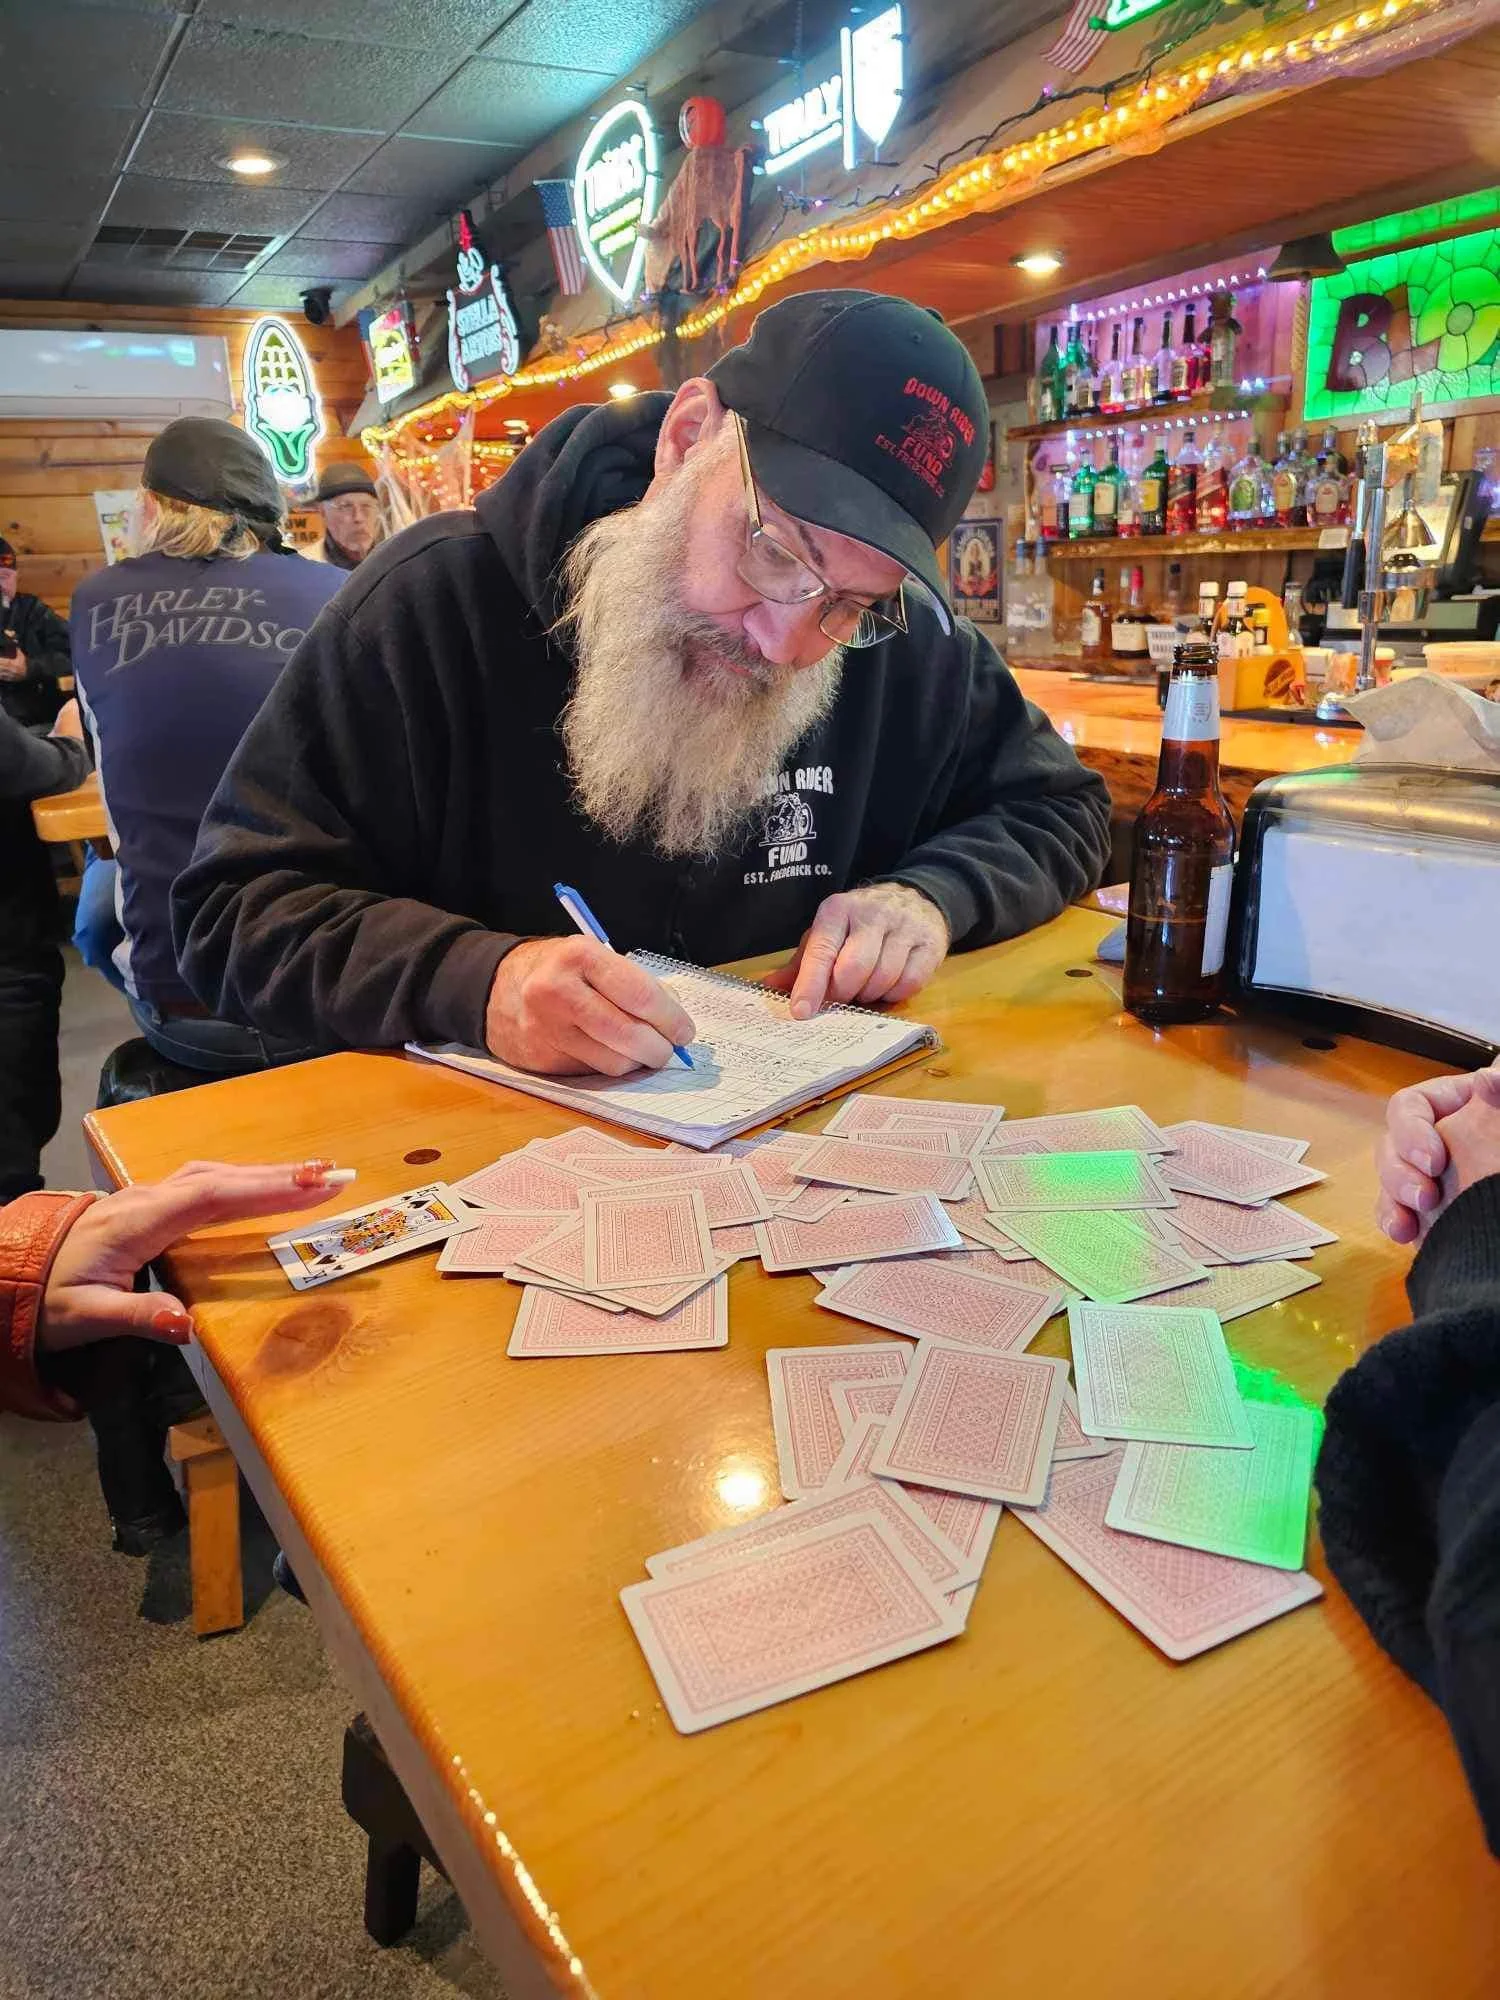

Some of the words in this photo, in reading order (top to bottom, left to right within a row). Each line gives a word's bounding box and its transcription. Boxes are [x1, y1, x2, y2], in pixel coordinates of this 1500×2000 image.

[904, 376, 950, 414] DOWN
[902, 436, 943, 477] FUND
[105, 616, 307, 676] DAVIDSO
[768, 842, 808, 868] FUND
[743, 872, 769, 885] EST.
[770, 864, 811, 882] FREDERICK
[814, 864, 832, 876] CO.
